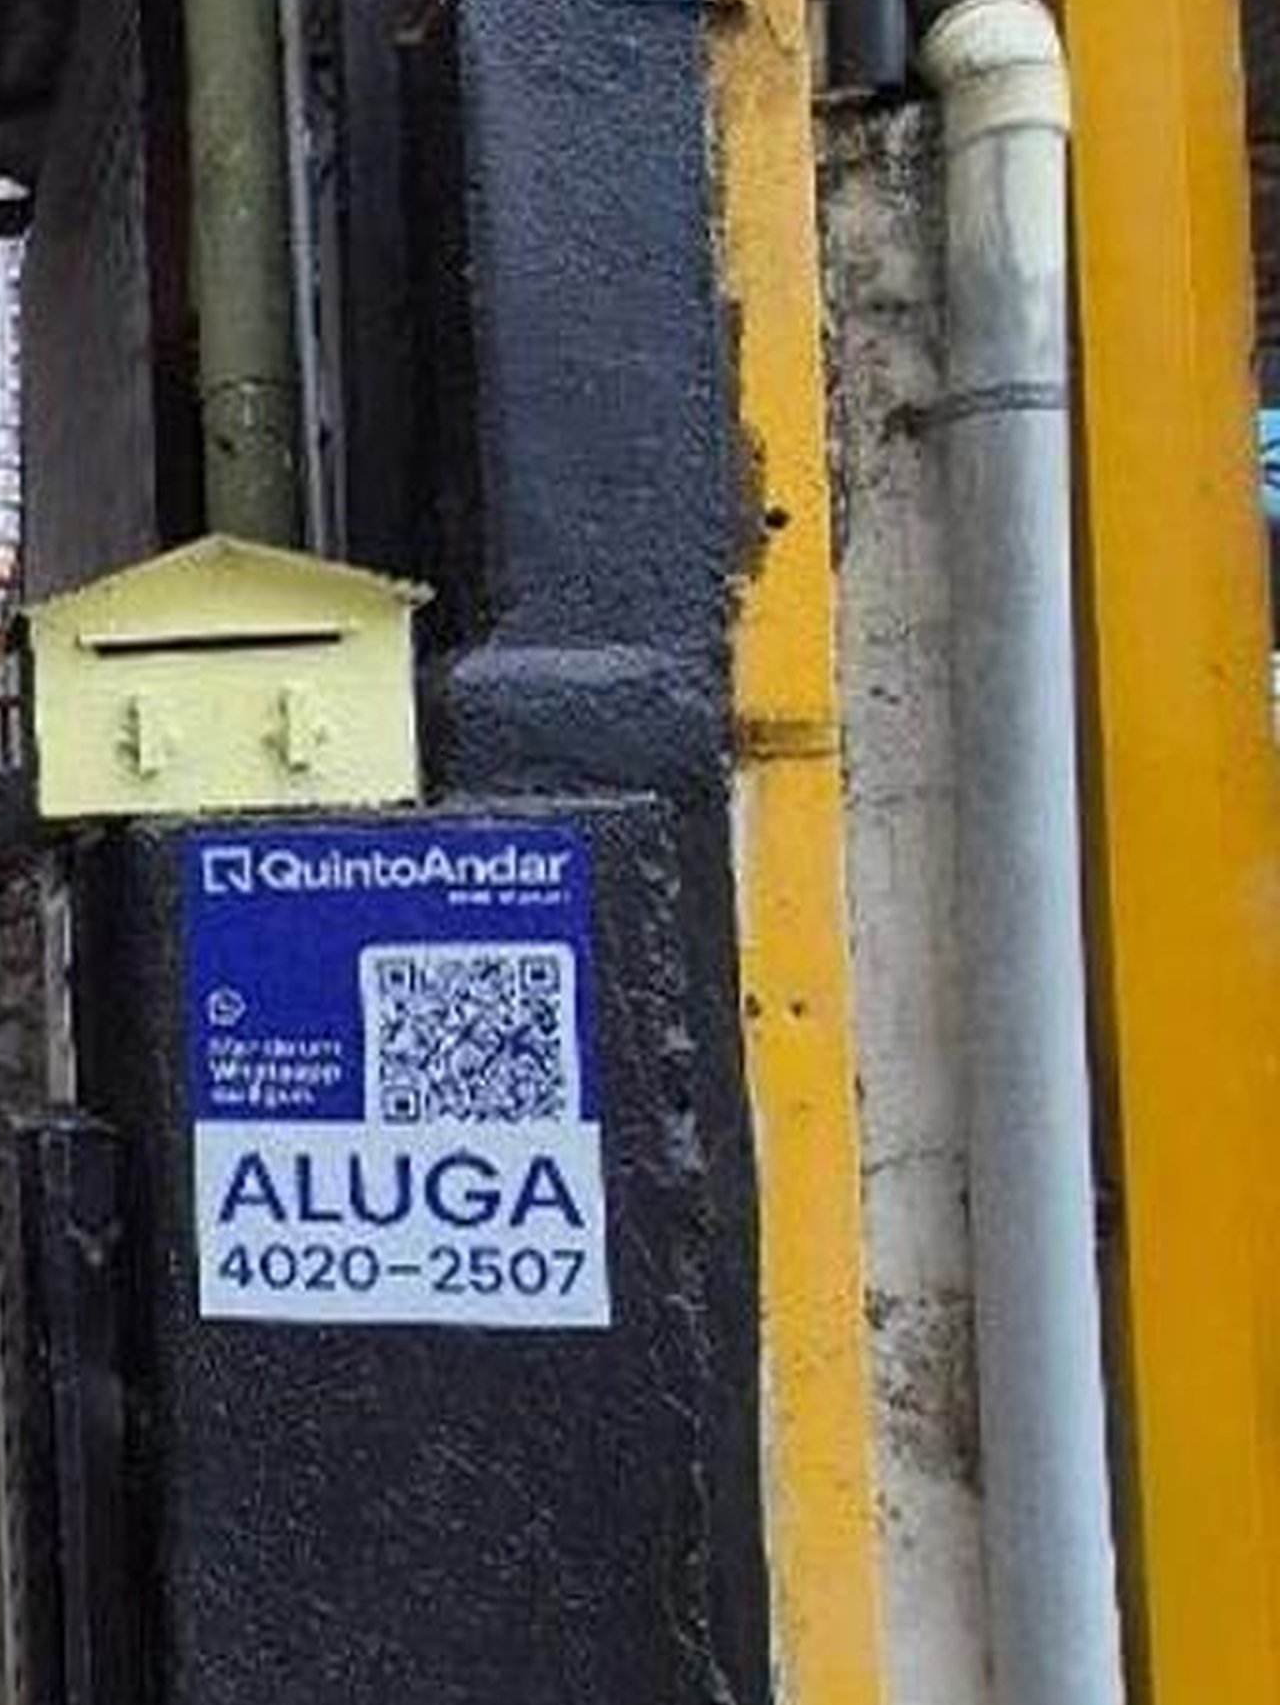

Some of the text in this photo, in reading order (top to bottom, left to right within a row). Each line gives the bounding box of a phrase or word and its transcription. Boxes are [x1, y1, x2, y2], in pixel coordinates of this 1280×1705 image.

[258, 846, 571, 889] QuintoAndar
[218, 1150, 584, 1228] ALUGA
[218, 1243, 586, 1296] 4020-2507
